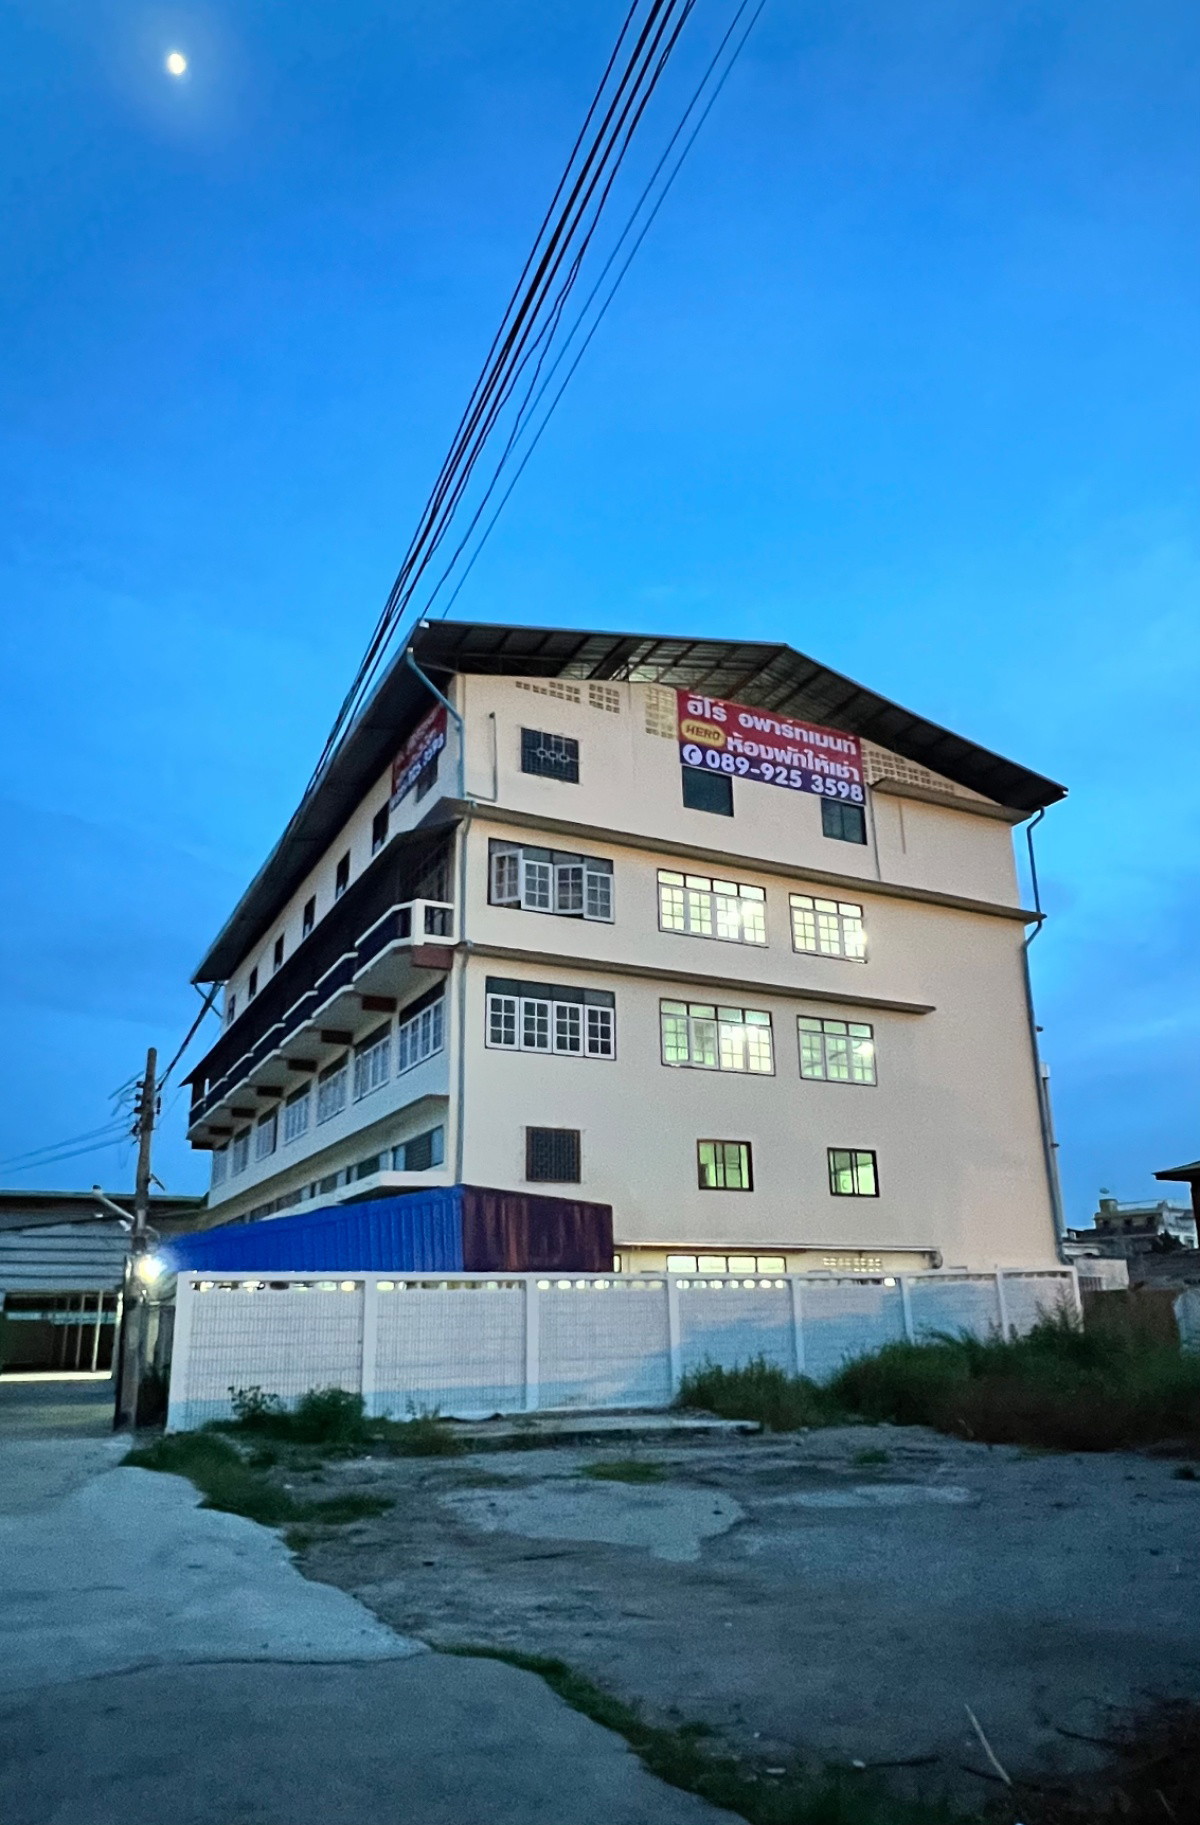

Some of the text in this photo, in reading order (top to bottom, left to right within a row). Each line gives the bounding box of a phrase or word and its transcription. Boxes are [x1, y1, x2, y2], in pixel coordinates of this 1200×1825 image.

[686, 725, 721, 741] HERO
[727, 731, 860, 782] ห้องพักให้เช่า
[705, 749, 864, 802] 089-925 3598
